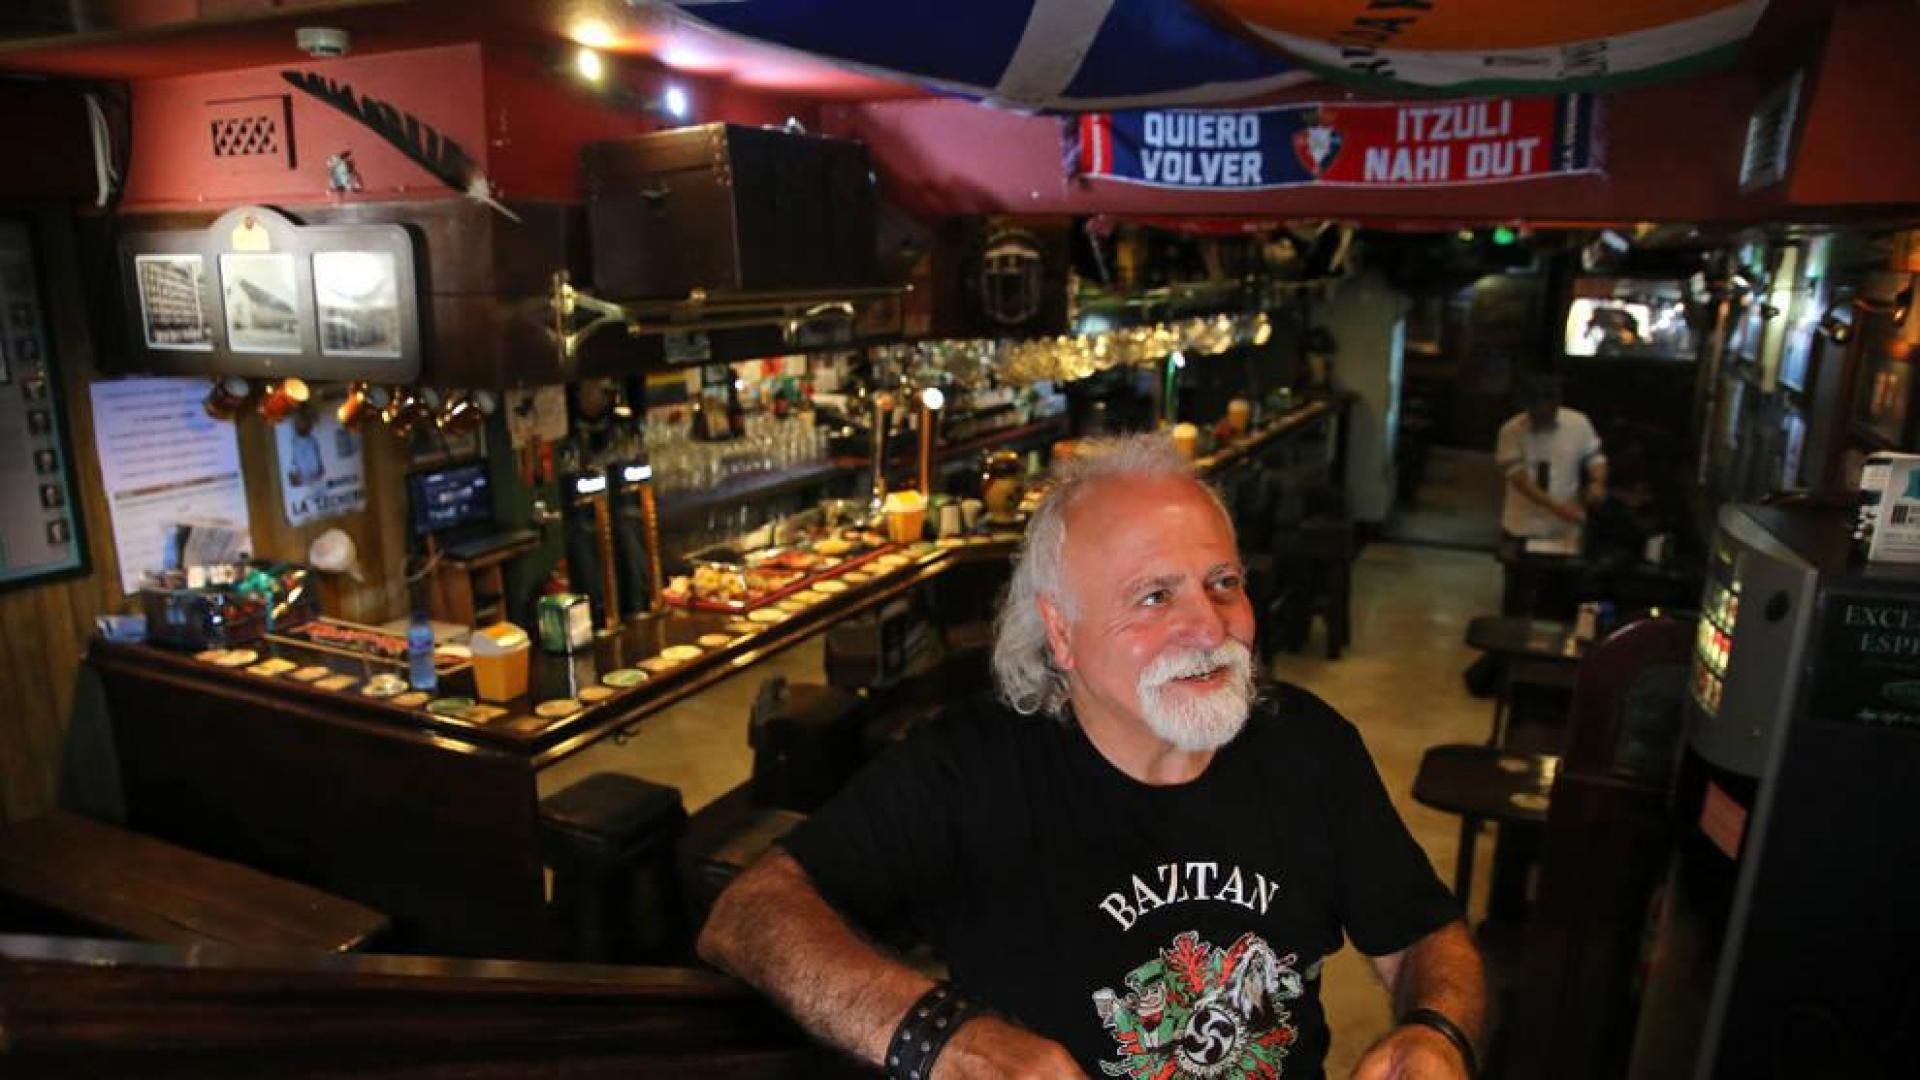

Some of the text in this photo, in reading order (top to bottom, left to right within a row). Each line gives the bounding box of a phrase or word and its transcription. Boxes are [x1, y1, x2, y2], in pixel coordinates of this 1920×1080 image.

[1143, 111, 1260, 148] QUIERO
[1397, 100, 1512, 142] ITZULI
[1140, 148, 1263, 185] VOLVER
[1364, 136, 1541, 182] NAHI DUT
[1098, 862, 1280, 933] BAZTAN
